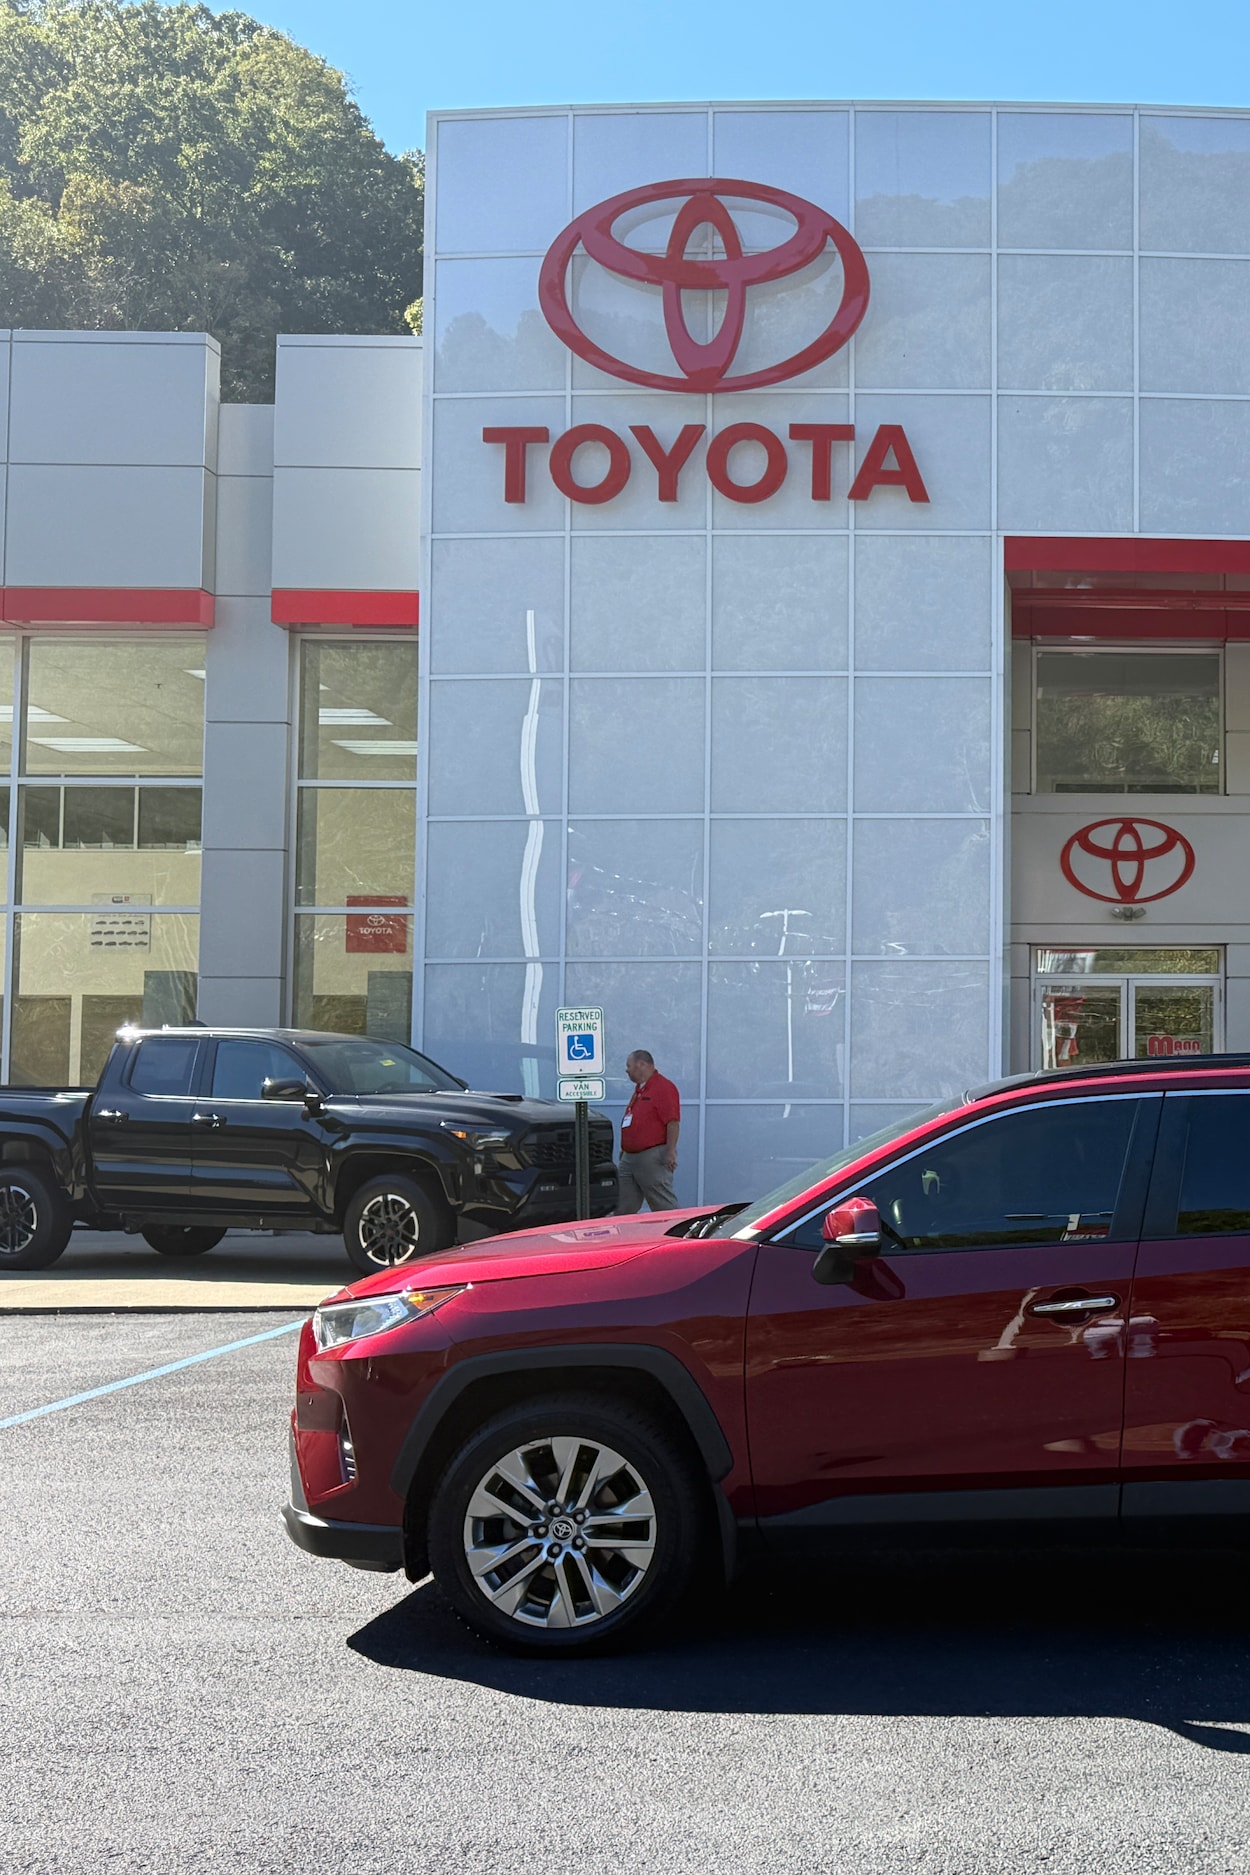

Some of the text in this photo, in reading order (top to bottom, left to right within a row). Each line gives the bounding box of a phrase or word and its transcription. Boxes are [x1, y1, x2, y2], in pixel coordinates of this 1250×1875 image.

[482, 422, 931, 505] TOYOTA
[358, 927, 393, 935] TOYOTA
[559, 1011, 600, 1021] RESERVED
[562, 1022, 598, 1032] PARKING
